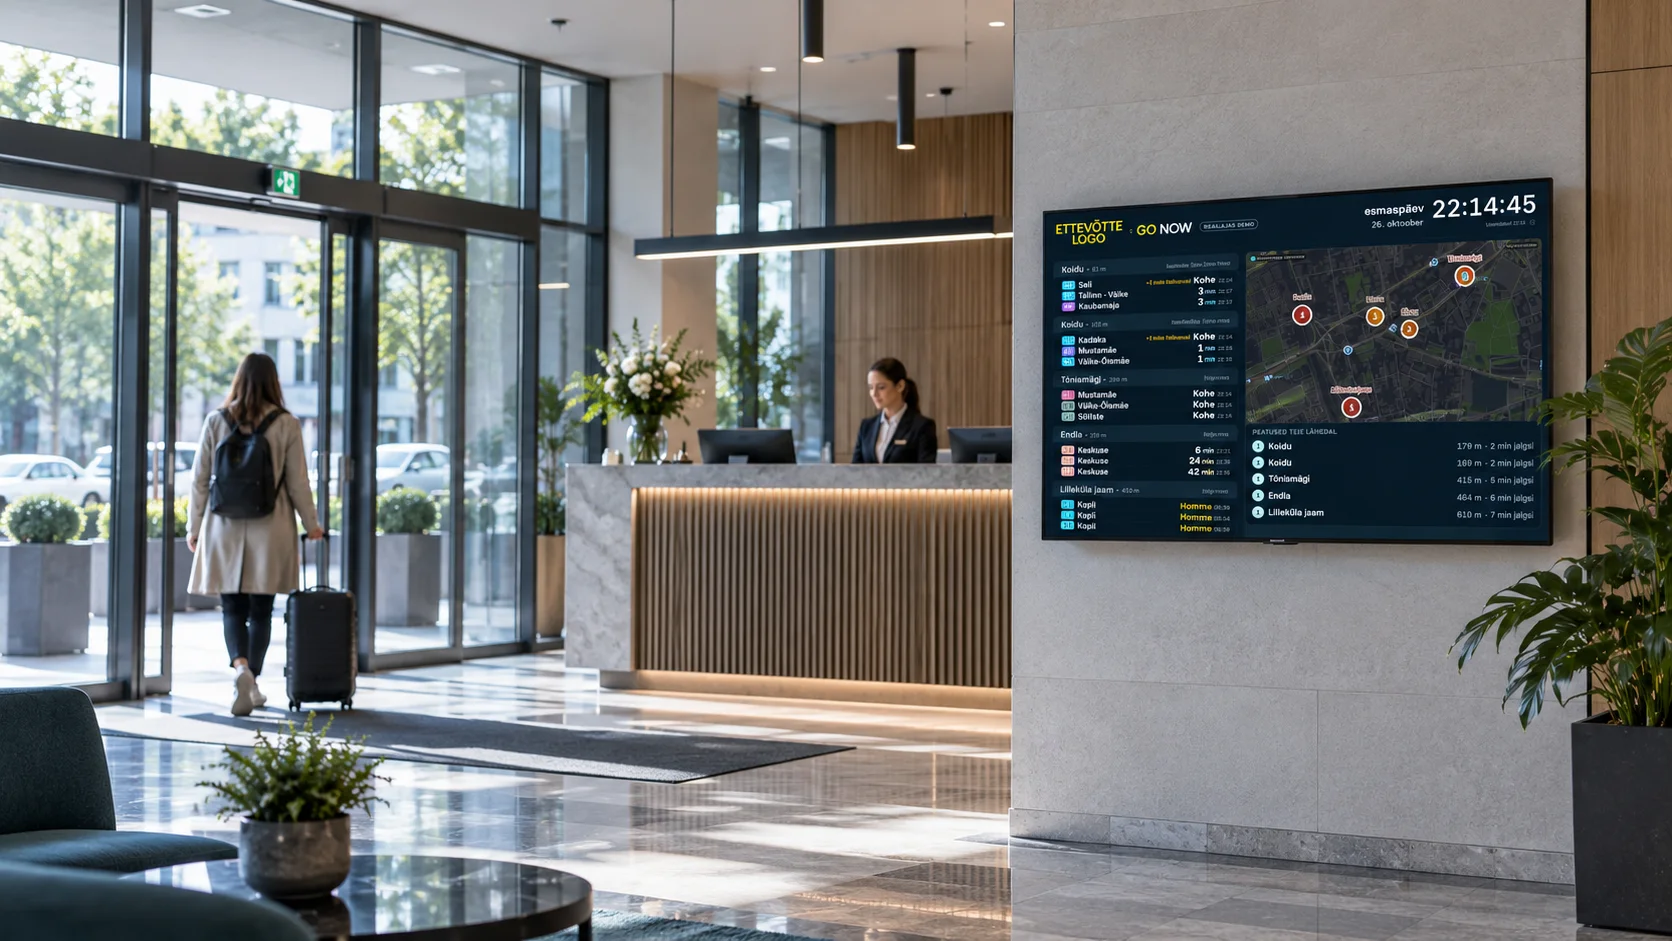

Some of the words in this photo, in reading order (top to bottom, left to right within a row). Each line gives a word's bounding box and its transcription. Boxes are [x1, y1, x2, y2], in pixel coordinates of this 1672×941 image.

[1364, 204, 1425, 217] esmaspäev
[1432, 194, 1537, 219] 22:14:45
[1055, 219, 1123, 235] ETTEVÕTTE
[1136, 224, 1157, 236] GO
[1159, 222, 1193, 235] NOW
[1371, 220, 1385, 229] 26.
[1072, 233, 1106, 245] LOGO
[1193, 276, 1216, 285] Kohe
[1198, 286, 1204, 296] 3
[1197, 297, 1204, 306] 3
[1193, 332, 1216, 341] Kohe
[1197, 343, 1204, 352] 1
[1197, 354, 1204, 363] 1
[1192, 389, 1215, 398] Kohe
[1192, 400, 1215, 409] Kohe
[1192, 411, 1215, 420] Kohe
[1195, 445, 1202, 454] 6
[1268, 442, 1292, 450] Koidu
[1490, 442, 1496, 450] 2
[1497, 441, 1512, 450] min
[1513, 441, 1535, 451] jalgsi
[1189, 456, 1201, 465] 24
[1268, 458, 1292, 467] Koidu
[1490, 459, 1496, 467] 2
[1497, 458, 1512, 467] min
[1513, 458, 1535, 468] jalgsi
[1187, 468, 1200, 476] 42
[1201, 468, 1215, 476] min
[1456, 476, 1473, 484] 415
[1490, 476, 1496, 484] 5
[1497, 475, 1512, 484] min
[1513, 475, 1535, 485] jalgsi
[1093, 485, 1115, 496] jaam
[1268, 492, 1291, 500] Endla
[1497, 493, 1512, 501] min
[1513, 493, 1535, 503] jalgsi
[1076, 500, 1097, 510] Kopli
[1180, 502, 1213, 510] Homme
[1076, 511, 1097, 520] Kopli
[1180, 513, 1213, 521] Homme
[1303, 509, 1325, 518] jaam
[1490, 511, 1496, 519] 7
[1497, 510, 1512, 519] min
[1513, 510, 1535, 520] jalgsi
[1180, 524, 1213, 532] Homme
